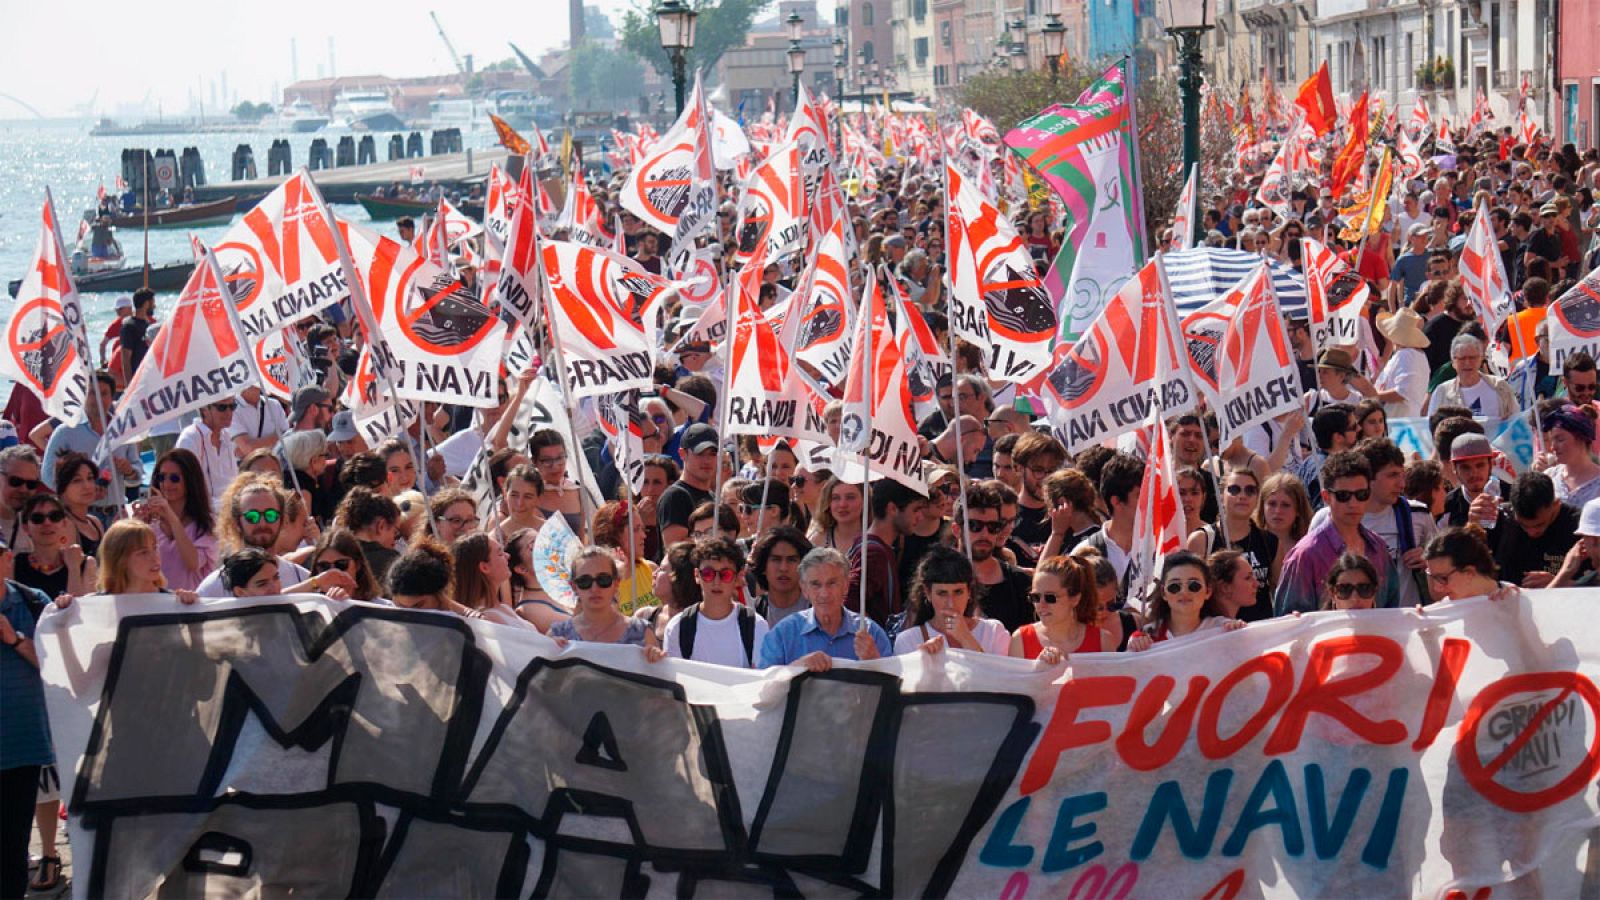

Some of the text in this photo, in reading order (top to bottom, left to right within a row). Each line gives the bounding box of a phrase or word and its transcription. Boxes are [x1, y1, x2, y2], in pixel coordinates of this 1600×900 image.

[416, 361, 492, 399] NAVI
[728, 397, 797, 428] RANDI
[1018, 636, 1471, 797] FUORI
[978, 759, 1409, 874] LE NAVI
